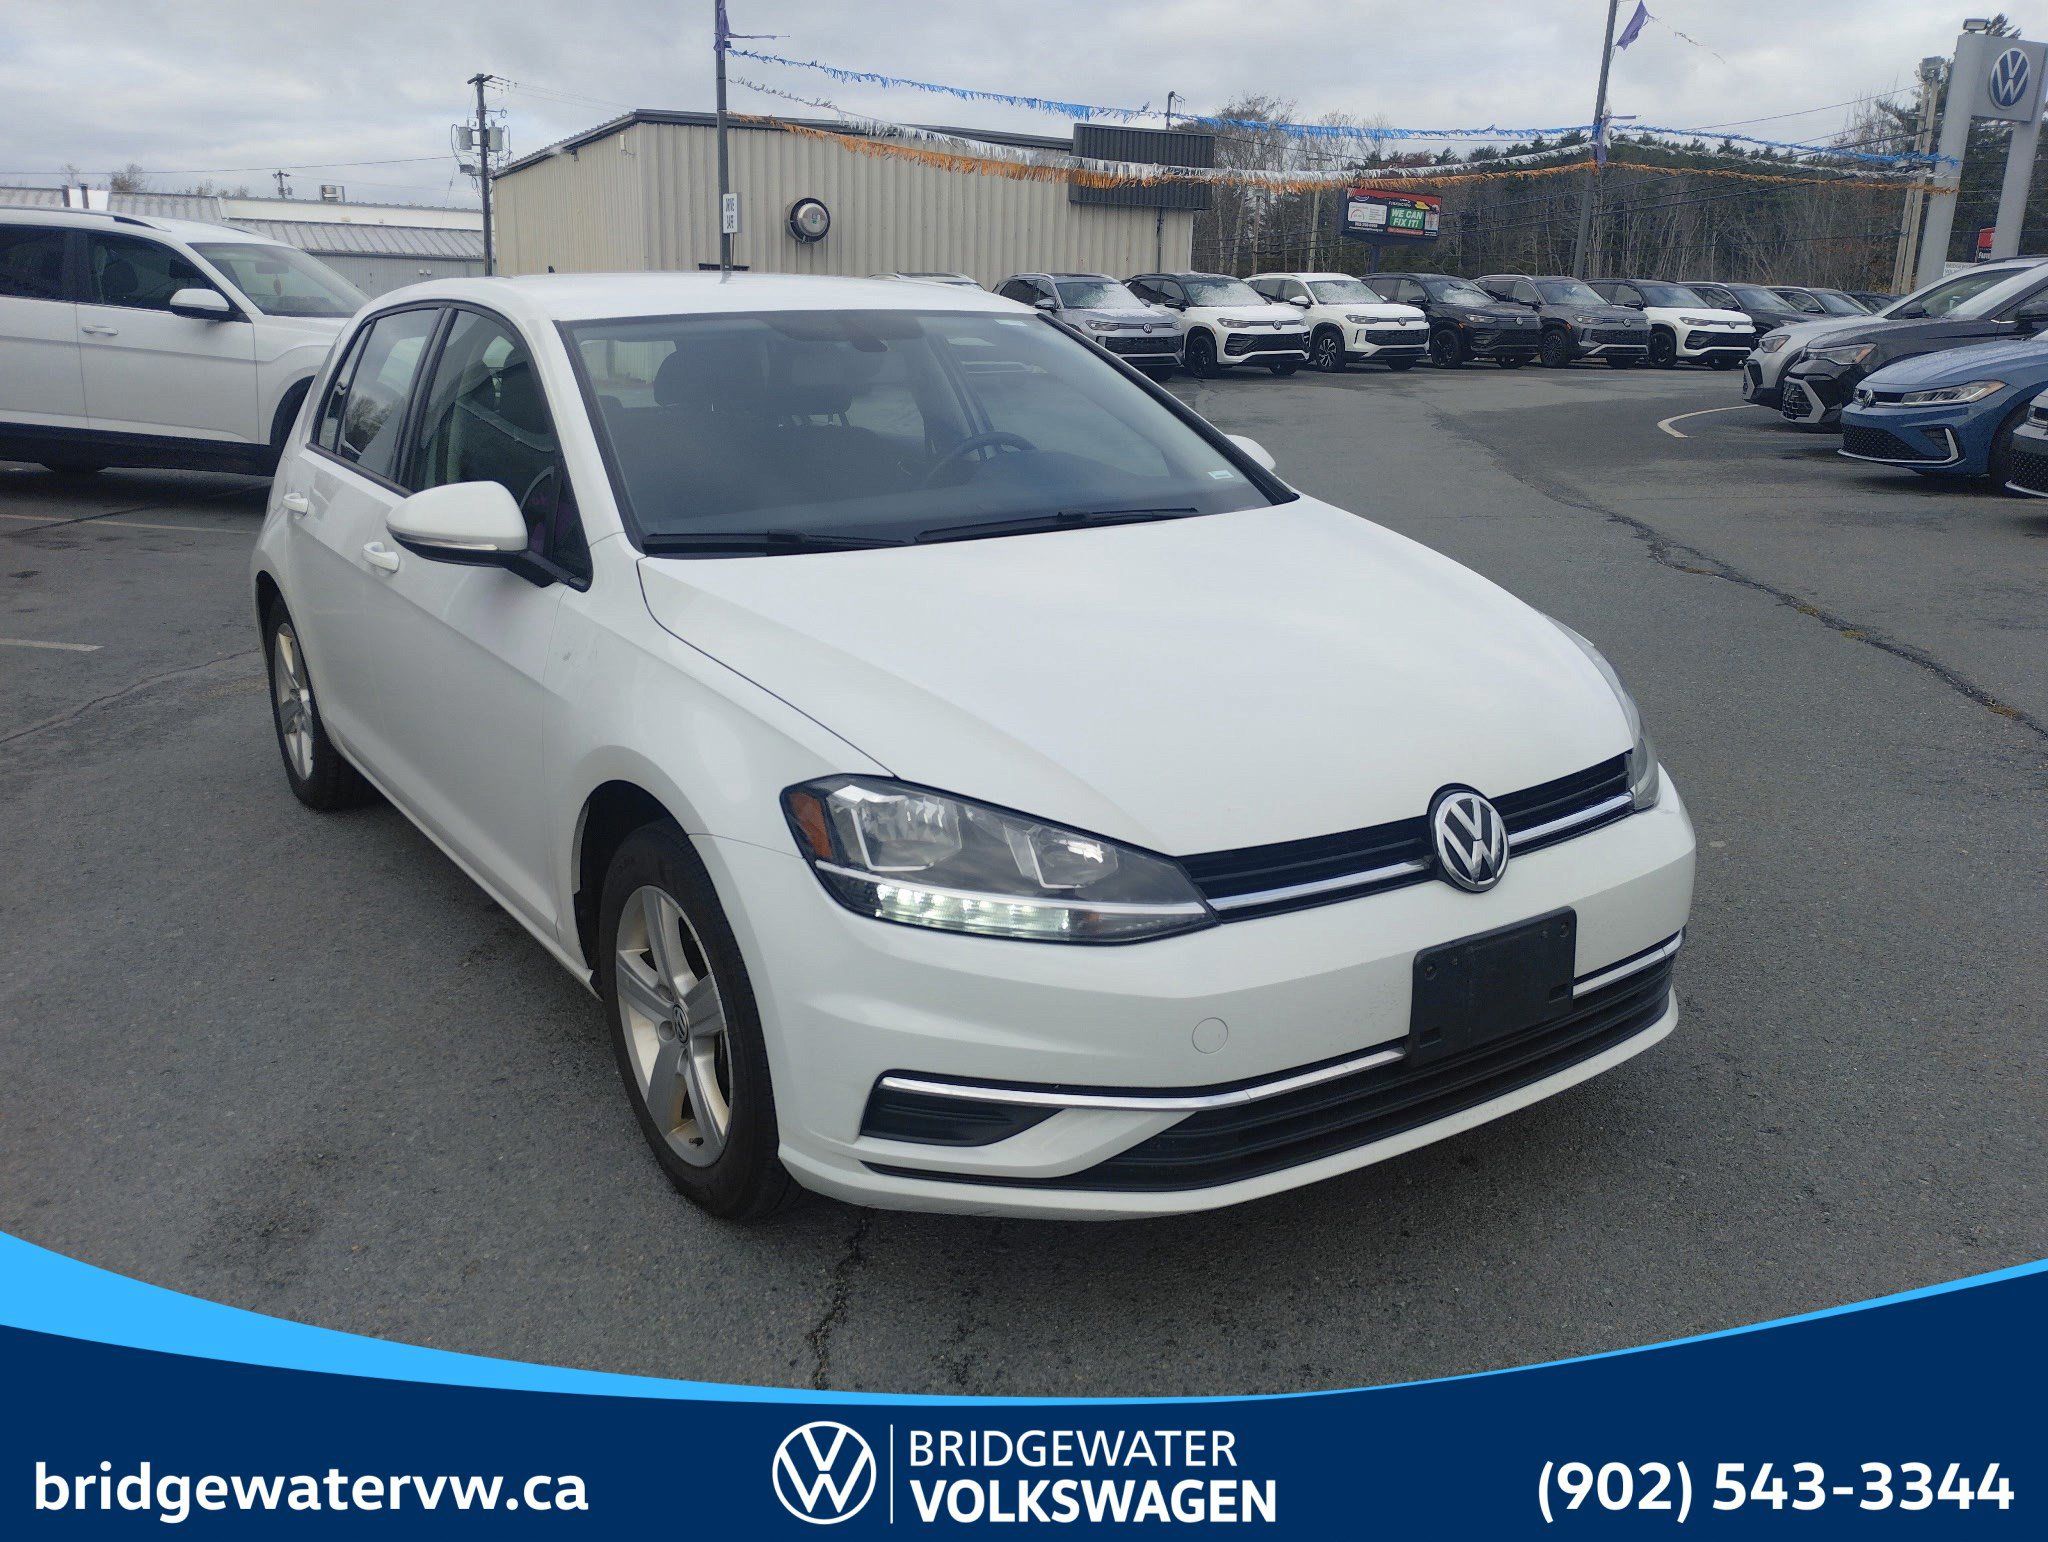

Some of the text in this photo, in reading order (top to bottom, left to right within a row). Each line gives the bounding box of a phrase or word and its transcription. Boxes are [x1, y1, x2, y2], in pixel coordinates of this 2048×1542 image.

[1392, 208, 1405, 218] WE
[1406, 210, 1422, 220] CAN
[1393, 218, 1418, 228] FIX IT!
